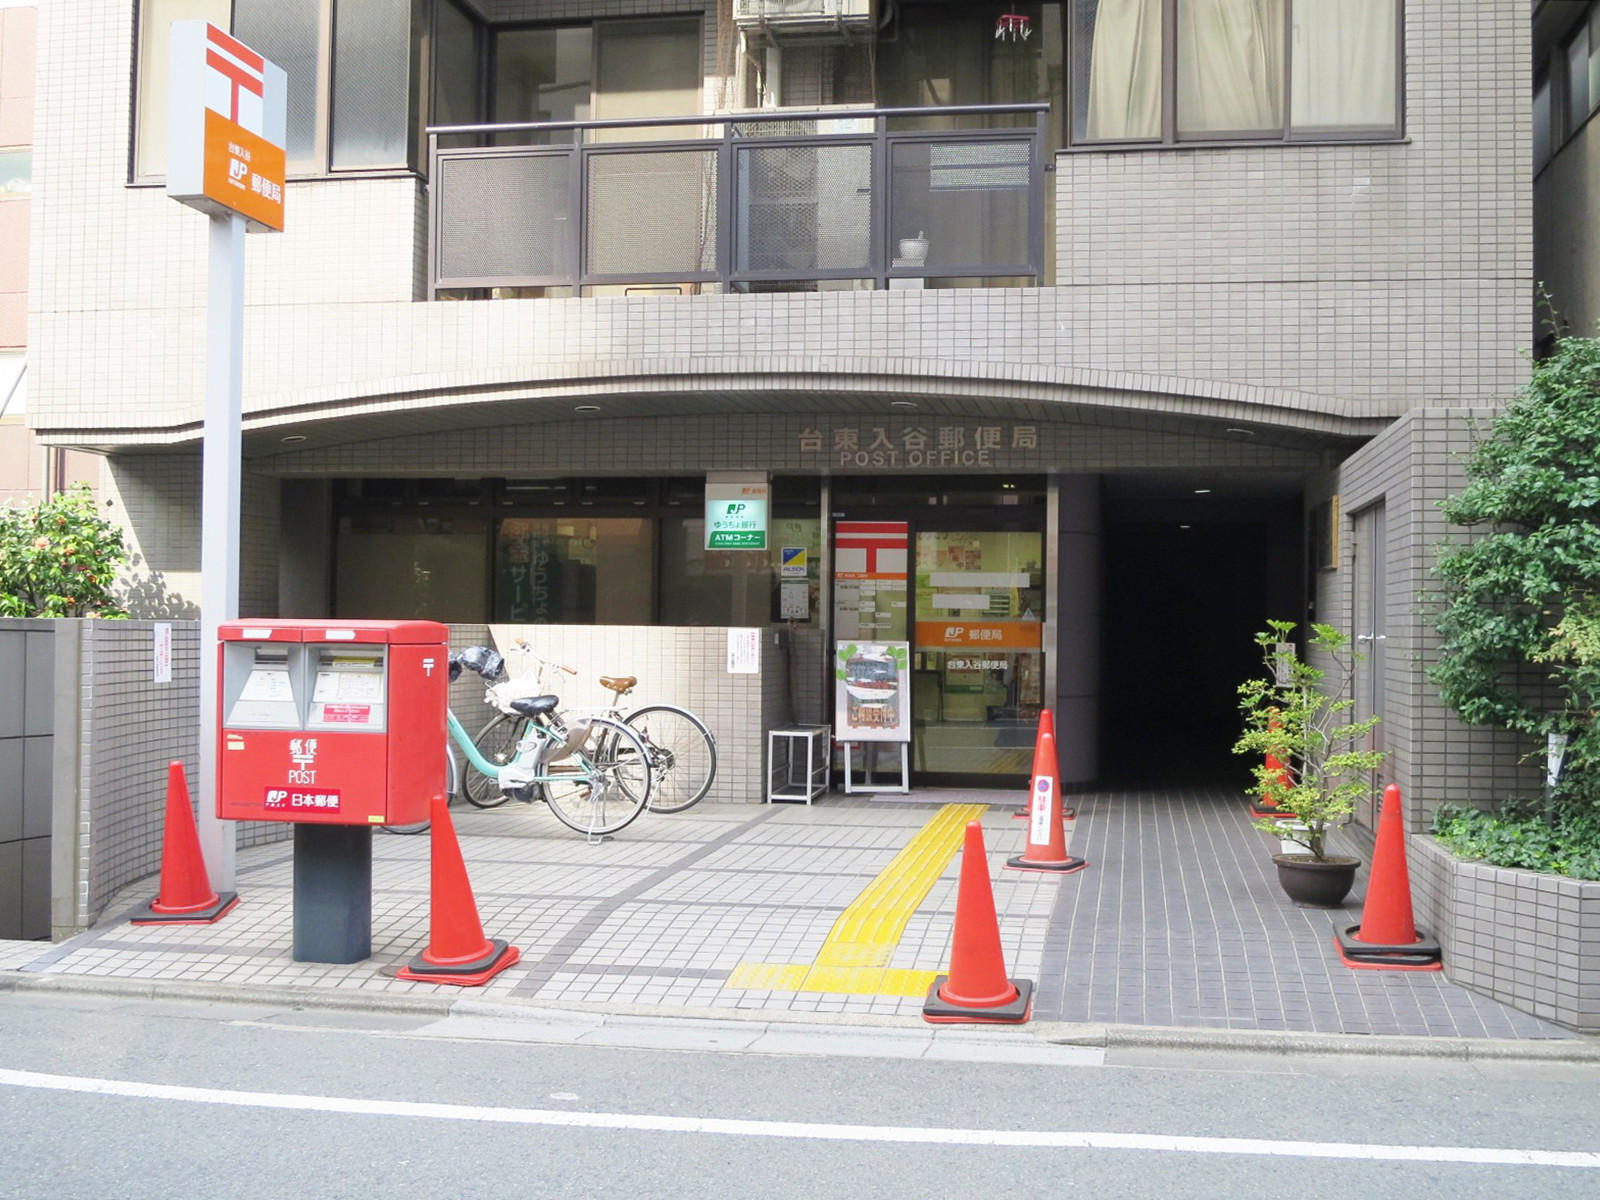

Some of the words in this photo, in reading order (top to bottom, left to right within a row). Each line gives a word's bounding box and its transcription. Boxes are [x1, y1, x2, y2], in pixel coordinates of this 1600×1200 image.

[251, 172, 282, 205] 郵便局
[798, 426, 1038, 451] 台東入谷郵便局
[840, 451, 898, 466] POST
[909, 451, 990, 466] OFFICE
[714, 520, 756, 529] ゆうちょ銀行
[715, 533, 760, 541] ATMコーナー
[969, 628, 1003, 641] 郵便局
[947, 659, 1008, 670] 台東入谷郵便局
[289, 738, 318, 755] 郵便
[288, 769, 317, 784] POST
[291, 793, 339, 808] 日本郵便
